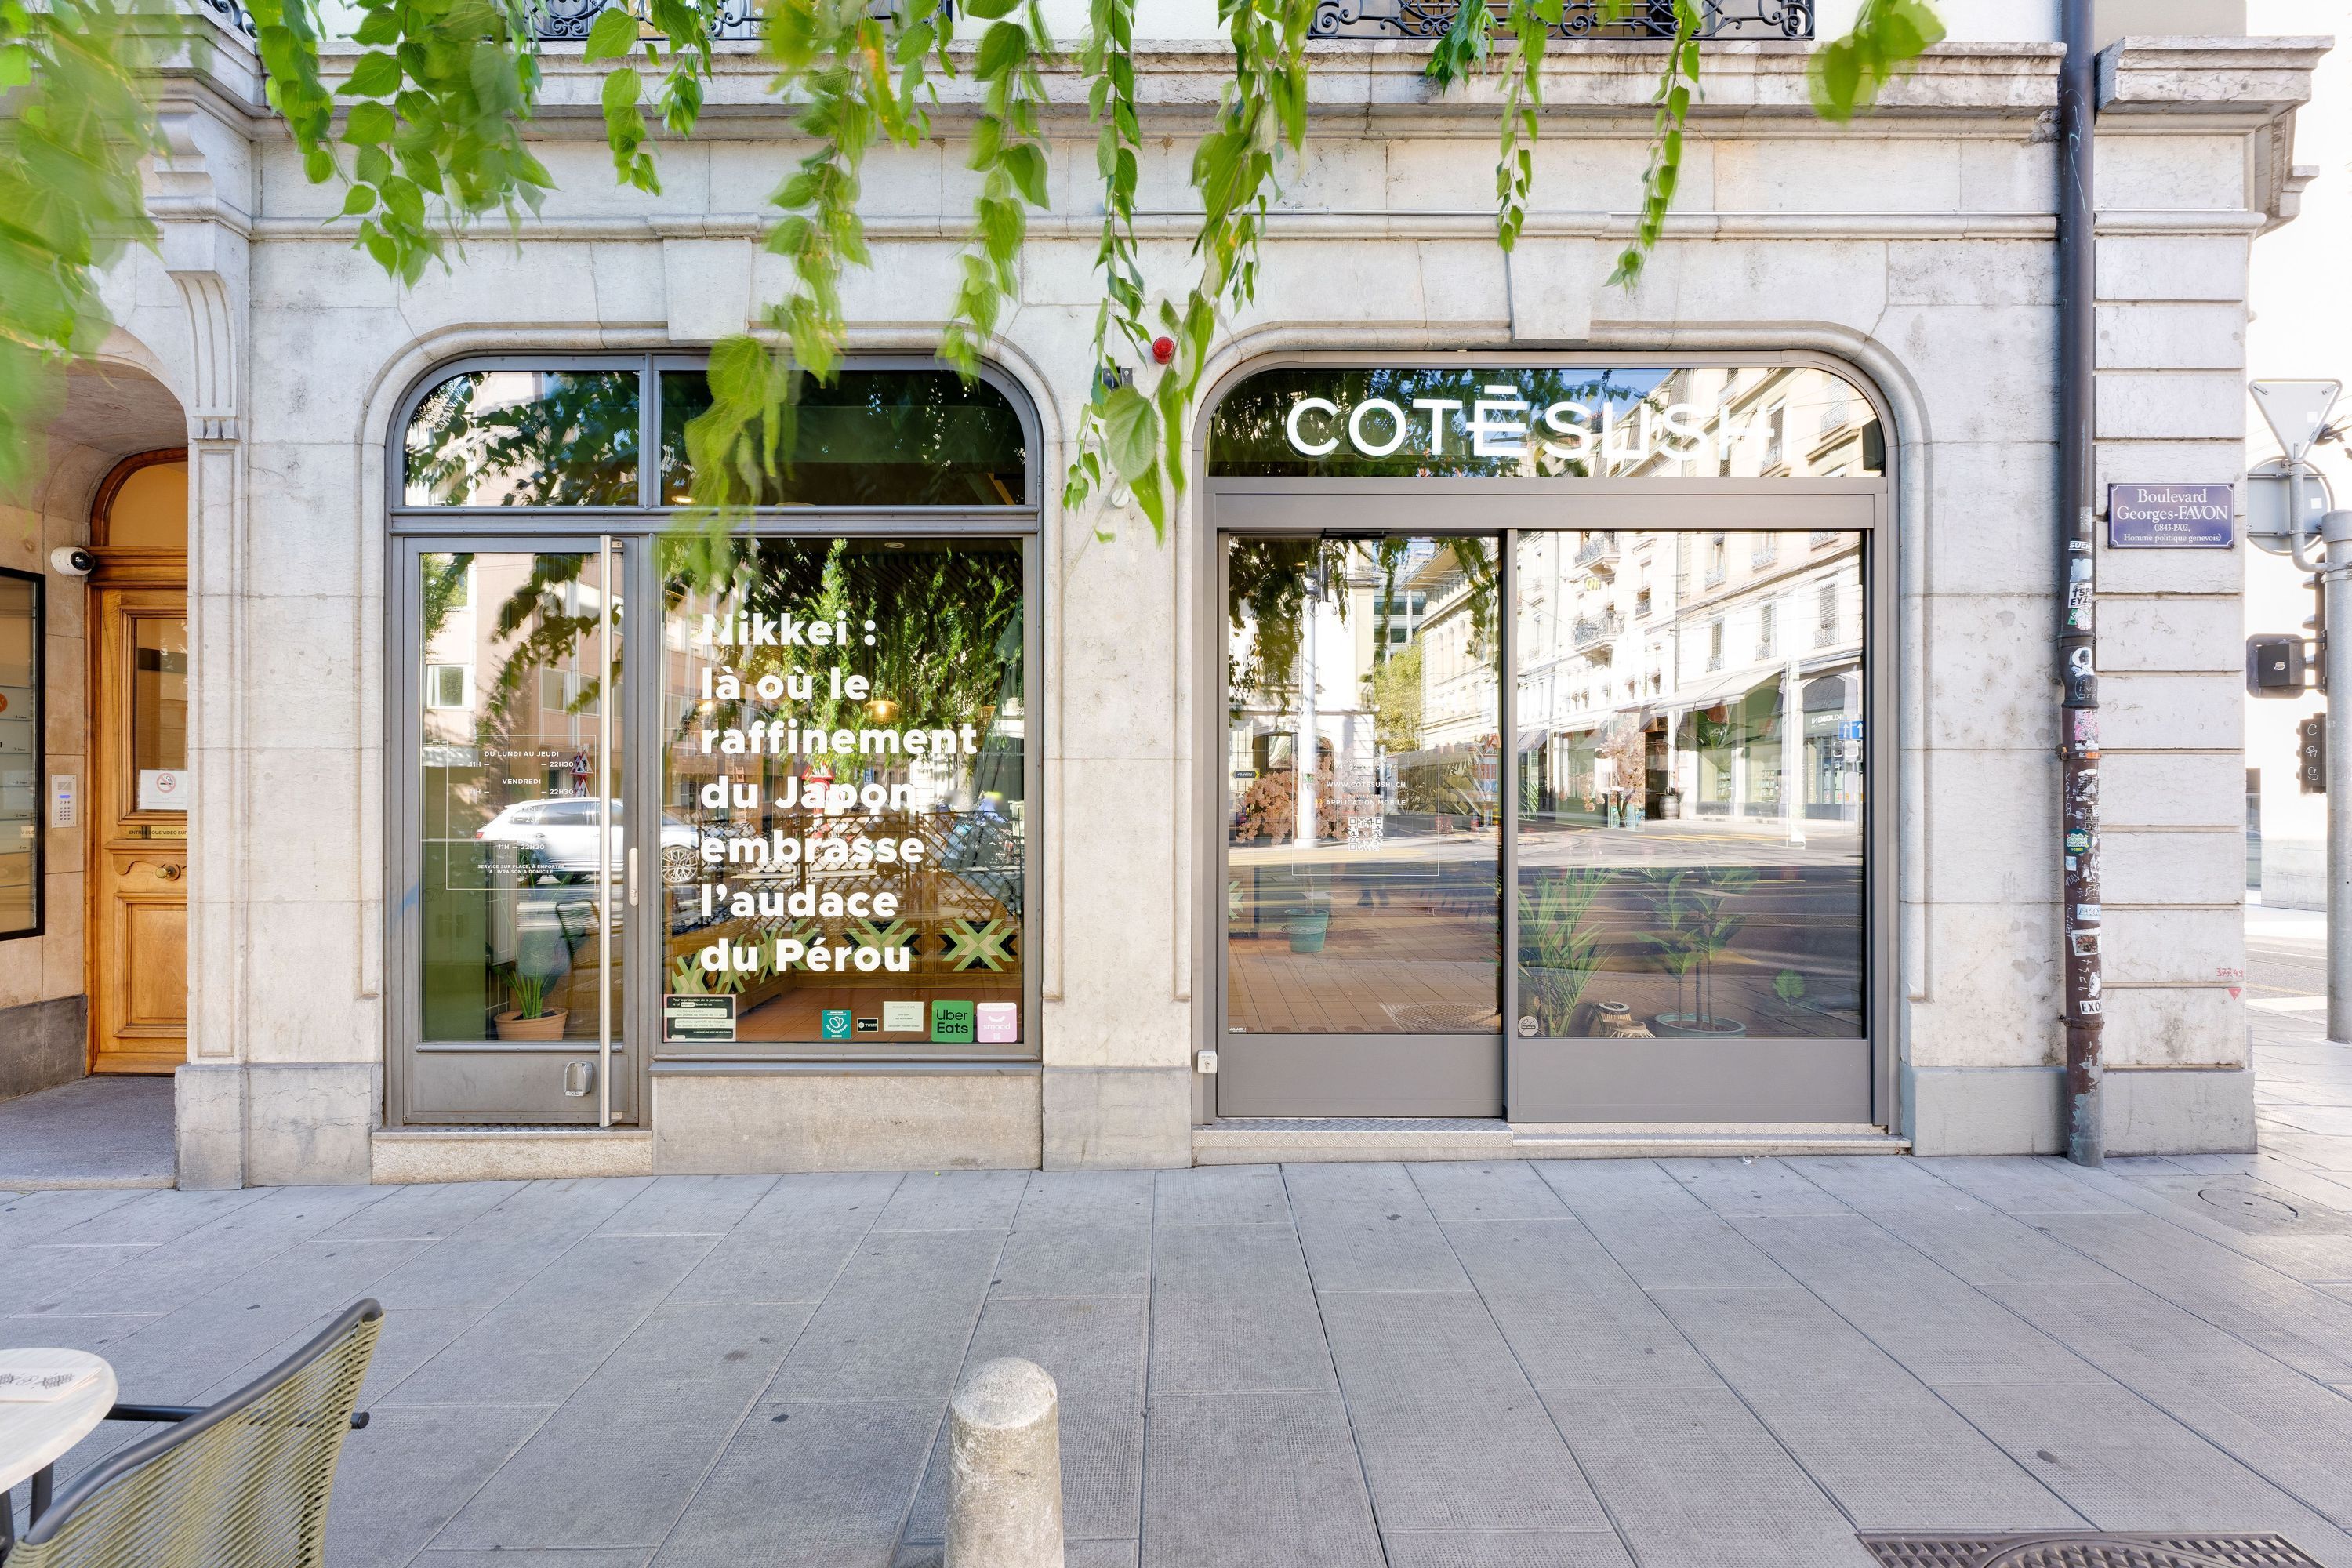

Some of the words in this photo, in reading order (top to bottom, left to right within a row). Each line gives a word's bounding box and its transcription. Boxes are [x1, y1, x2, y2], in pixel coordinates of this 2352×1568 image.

[2137, 488, 2207, 503] Boulevard
[2117, 506, 2227, 523] Georges-FAVON
[2154, 524, 2190, 532] (1843-1902,
[2154, 533, 2187, 543] politique
[2189, 533, 2221, 543] genevois)
[702, 611, 847, 646] Nikkei
[702, 667, 740, 700] là
[757, 666, 813, 700] où
[831, 667, 870, 700] le
[702, 720, 978, 754] raffinement
[701, 776, 759, 808] du
[775, 776, 916, 816] Japon
[701, 830, 924, 864] embrasse
[701, 938, 758, 972] du
[775, 938, 910, 972] Pérou
[936, 1009, 967, 1021] Uber
[937, 1022, 969, 1033] Eats
